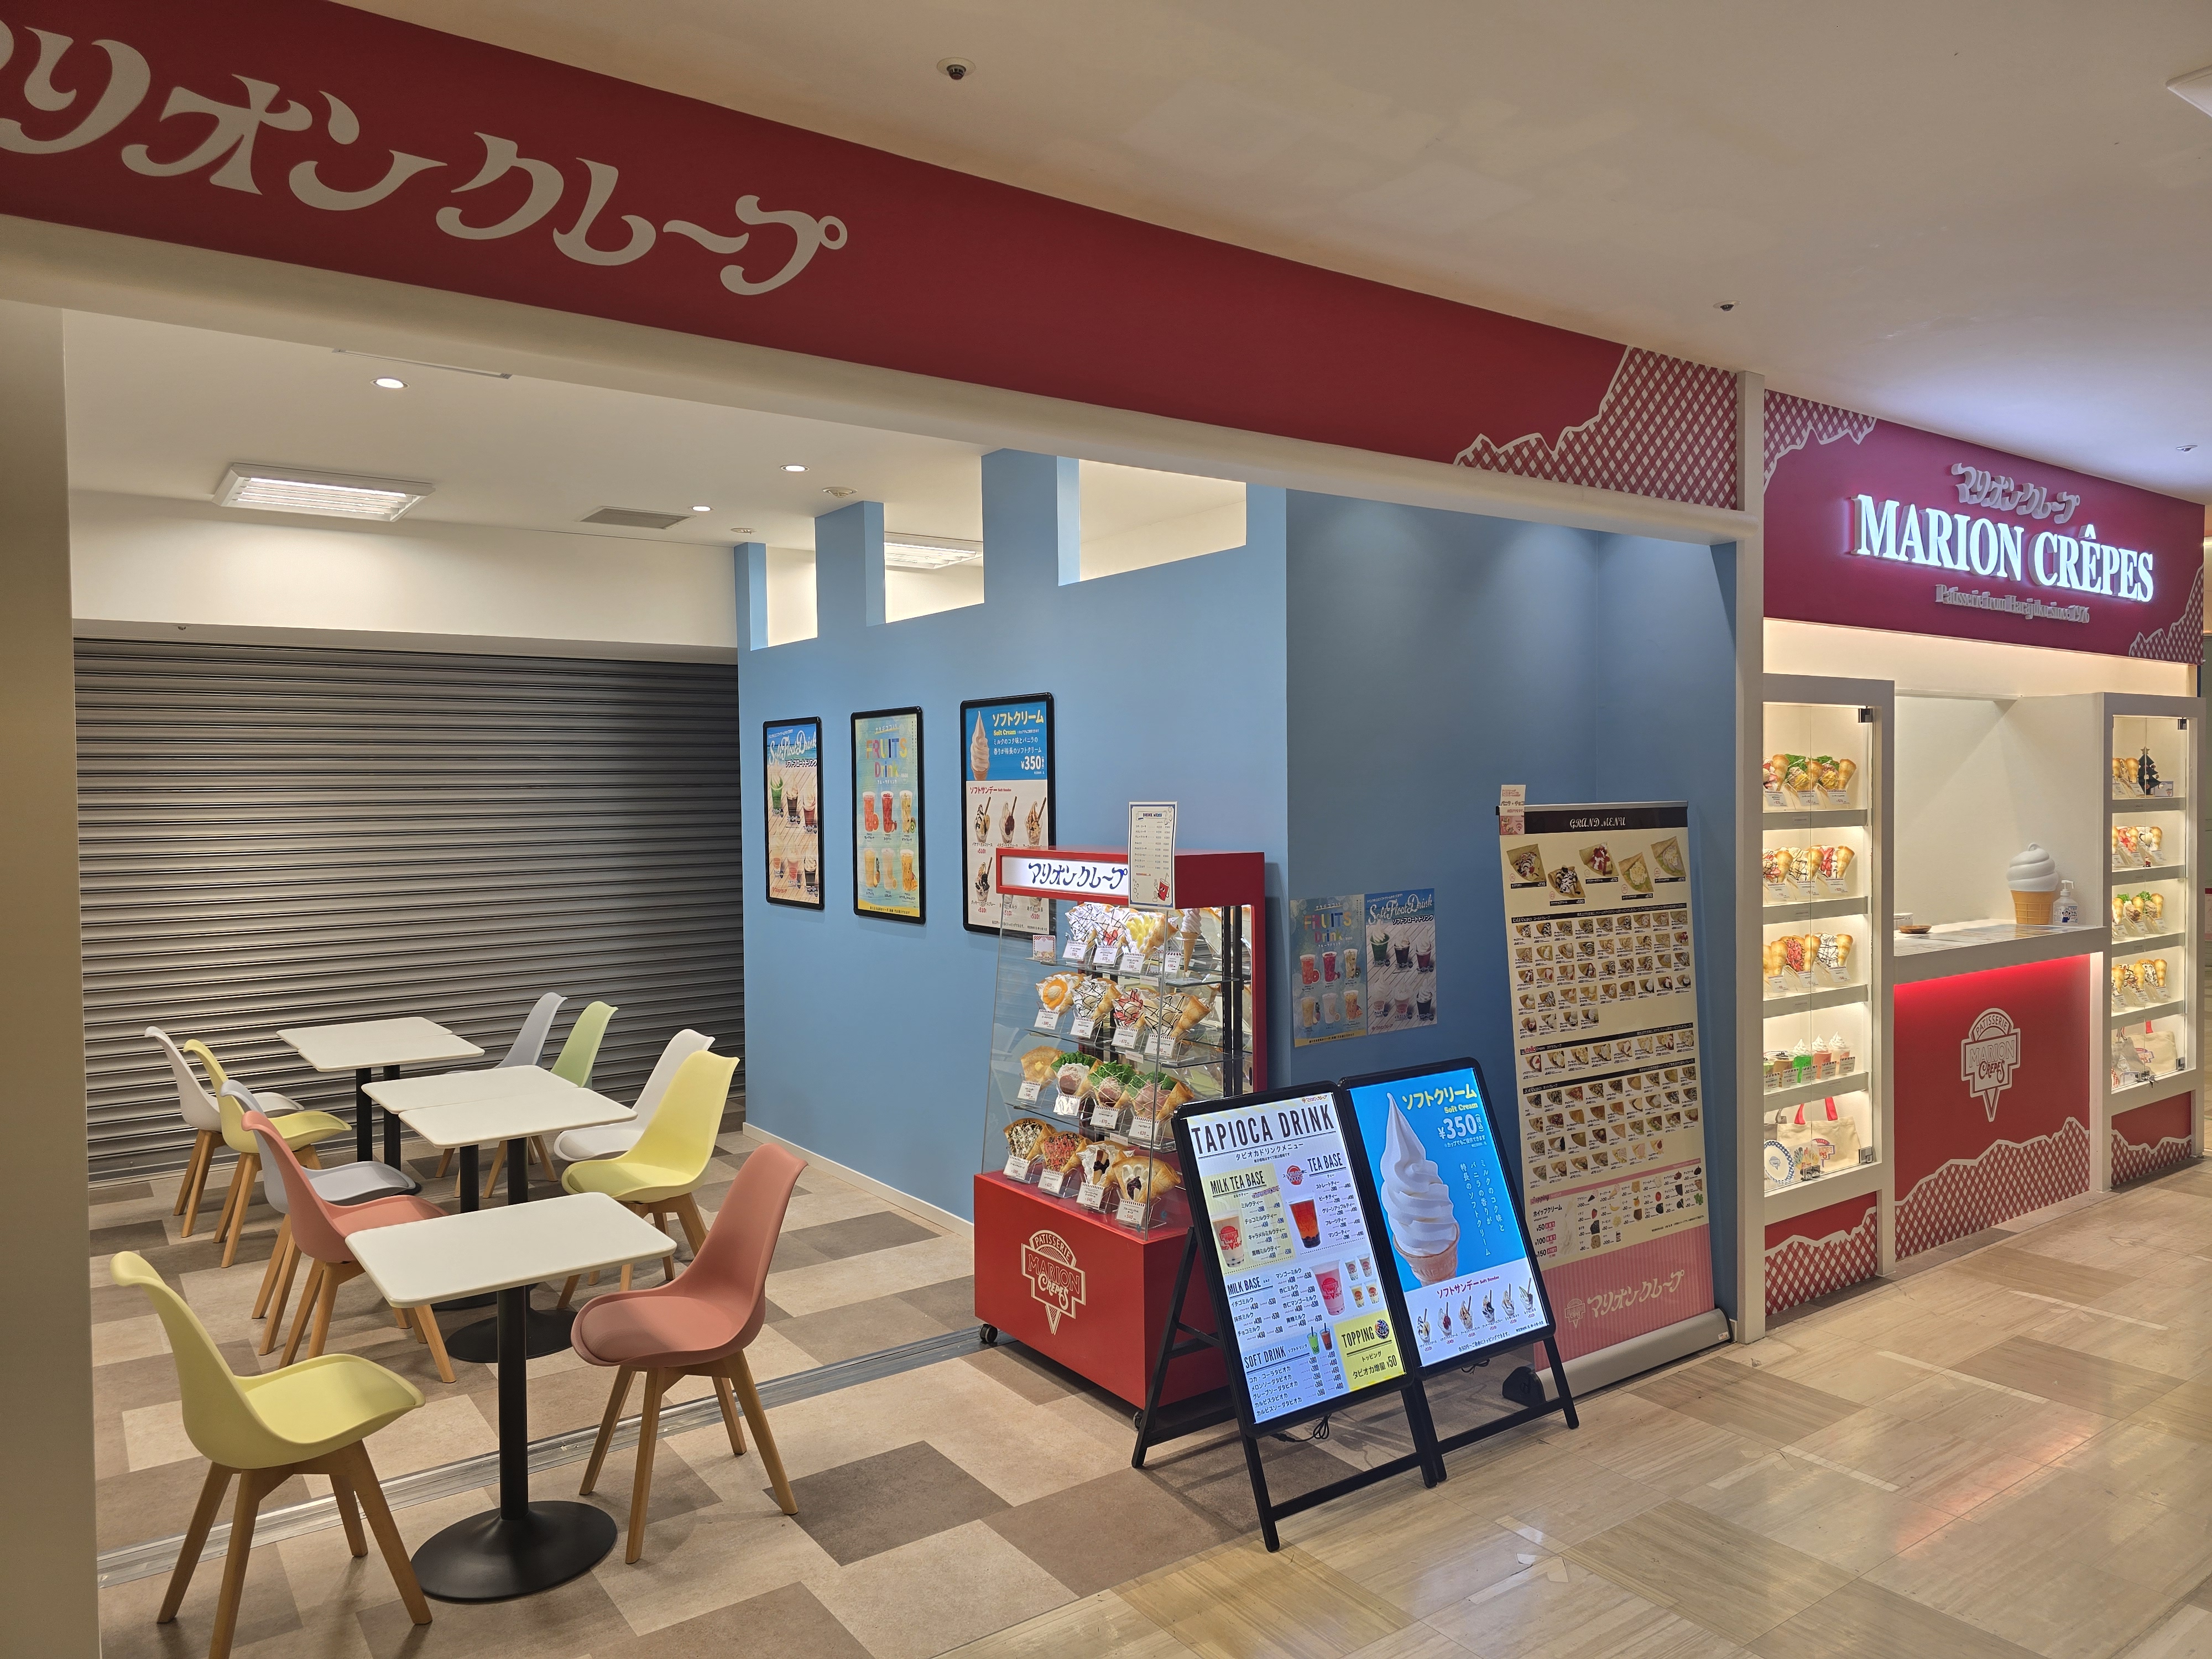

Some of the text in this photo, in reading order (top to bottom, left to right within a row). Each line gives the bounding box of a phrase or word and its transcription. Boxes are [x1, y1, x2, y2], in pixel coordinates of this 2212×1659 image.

[1952, 463, 2080, 524] マリオンクレープ
[1850, 494, 2154, 603] MARION CRÊPES
[1936, 585, 2090, 623] Patisserie from Harajuku since 1976
[992, 709, 1044, 727] ソフトクリーム
[866, 737, 907, 759] FRUITS
[874, 760, 899, 778] Drink
[1020, 755, 1041, 770] ¥350
[970, 786, 998, 794] ソフトサンデー
[1569, 817, 1626, 828] GRAND MENU
[1028, 862, 1128, 890] マリオンクレープ
[1304, 911, 1352, 930] FRUITS
[1392, 915, 1434, 925] ソフトフロートドリンク
[1314, 928, 1343, 943] Drink
[1975, 1015, 2008, 1036] PATISSERIE
[1521, 1046, 1536, 1055] nutella
[1969, 1040, 2015, 1068] MARION
[1979, 1060, 2005, 1083] CREPES
[1402, 1083, 1478, 1110] ソフトクリーム
[1458, 1103, 1478, 1112] Cream
[1191, 1104, 1334, 1154] TAPIOCA DRINK
[1437, 1114, 1477, 1140] ¥350
[1235, 1142, 1304, 1161] タピオカドリンクメニュー
[1307, 1152, 1343, 1172] TEA BASE
[1210, 1177, 1229, 1195] MILK
[1229, 1175, 1245, 1191] TEA
[1245, 1170, 1265, 1187] BASE
[1316, 1180, 1340, 1190] ストレートティー
[1318, 1193, 1338, 1202] ピーチティー
[1470, 1161, 1493, 1225] バニラの香りが
[1480, 1159, 1505, 1232] ミルクのコク味と
[1241, 1200, 1263, 1209] ミルクティー
[1322, 1202, 1355, 1214] グリーンアップルティー
[1459, 1163, 1491, 1256] 特長のソフトクリーム
[1533, 1204, 1562, 1218] ホイップクリーム
[1244, 1213, 1277, 1225] チョコミルクティー
[1325, 1217, 1347, 1226] フルーツティー
[1536, 1223, 1545, 1232] ¥50
[1248, 1228, 1286, 1240] キャラメルミルクティー
[1328, 1229, 1350, 1239] マンゴーティー
[1535, 1237, 1546, 1245] ¥100
[1034, 1234, 1071, 1261] PATISSERIE
[1251, 1245, 1281, 1256] 黒糖ミルクティー
[1028, 1254, 1080, 1295] MARION
[1275, 1268, 1302, 1279] マンゴーミルク
[1037, 1273, 1069, 1310] CREPES
[1227, 1276, 1261, 1296] MILK BASE
[1279, 1284, 1298, 1294] 杏仁ミルク
[1437, 1280, 1479, 1299] ソフトサンデー
[1587, 1269, 1685, 1318] マリオンクレープ
[1231, 1297, 1254, 1308] イチゴミルク
[1282, 1295, 1317, 1309] 杏仁マンゴーミルク
[1237, 1326, 1260, 1337] チョコミルク
[1341, 1326, 1375, 1348] TOPPING
[1244, 1345, 1287, 1369] SOFT DRINK
[1287, 1344, 1308, 1353] ソフトドリンク
[1362, 1350, 1381, 1363] トッピング
[1249, 1365, 1291, 1384] コカ・コーラタピオカ
[1353, 1354, 1397, 1380] タピオカ増量 ¥50
[1251, 1374, 1292, 1391] メロンソーダタピオカ
[1253, 1380, 1298, 1400] グレープソーダタピオカ
[1254, 1392, 1288, 1408] カルピスタピオカ
[1256, 1397, 1302, 1417] カルピスソーダタピオカ
